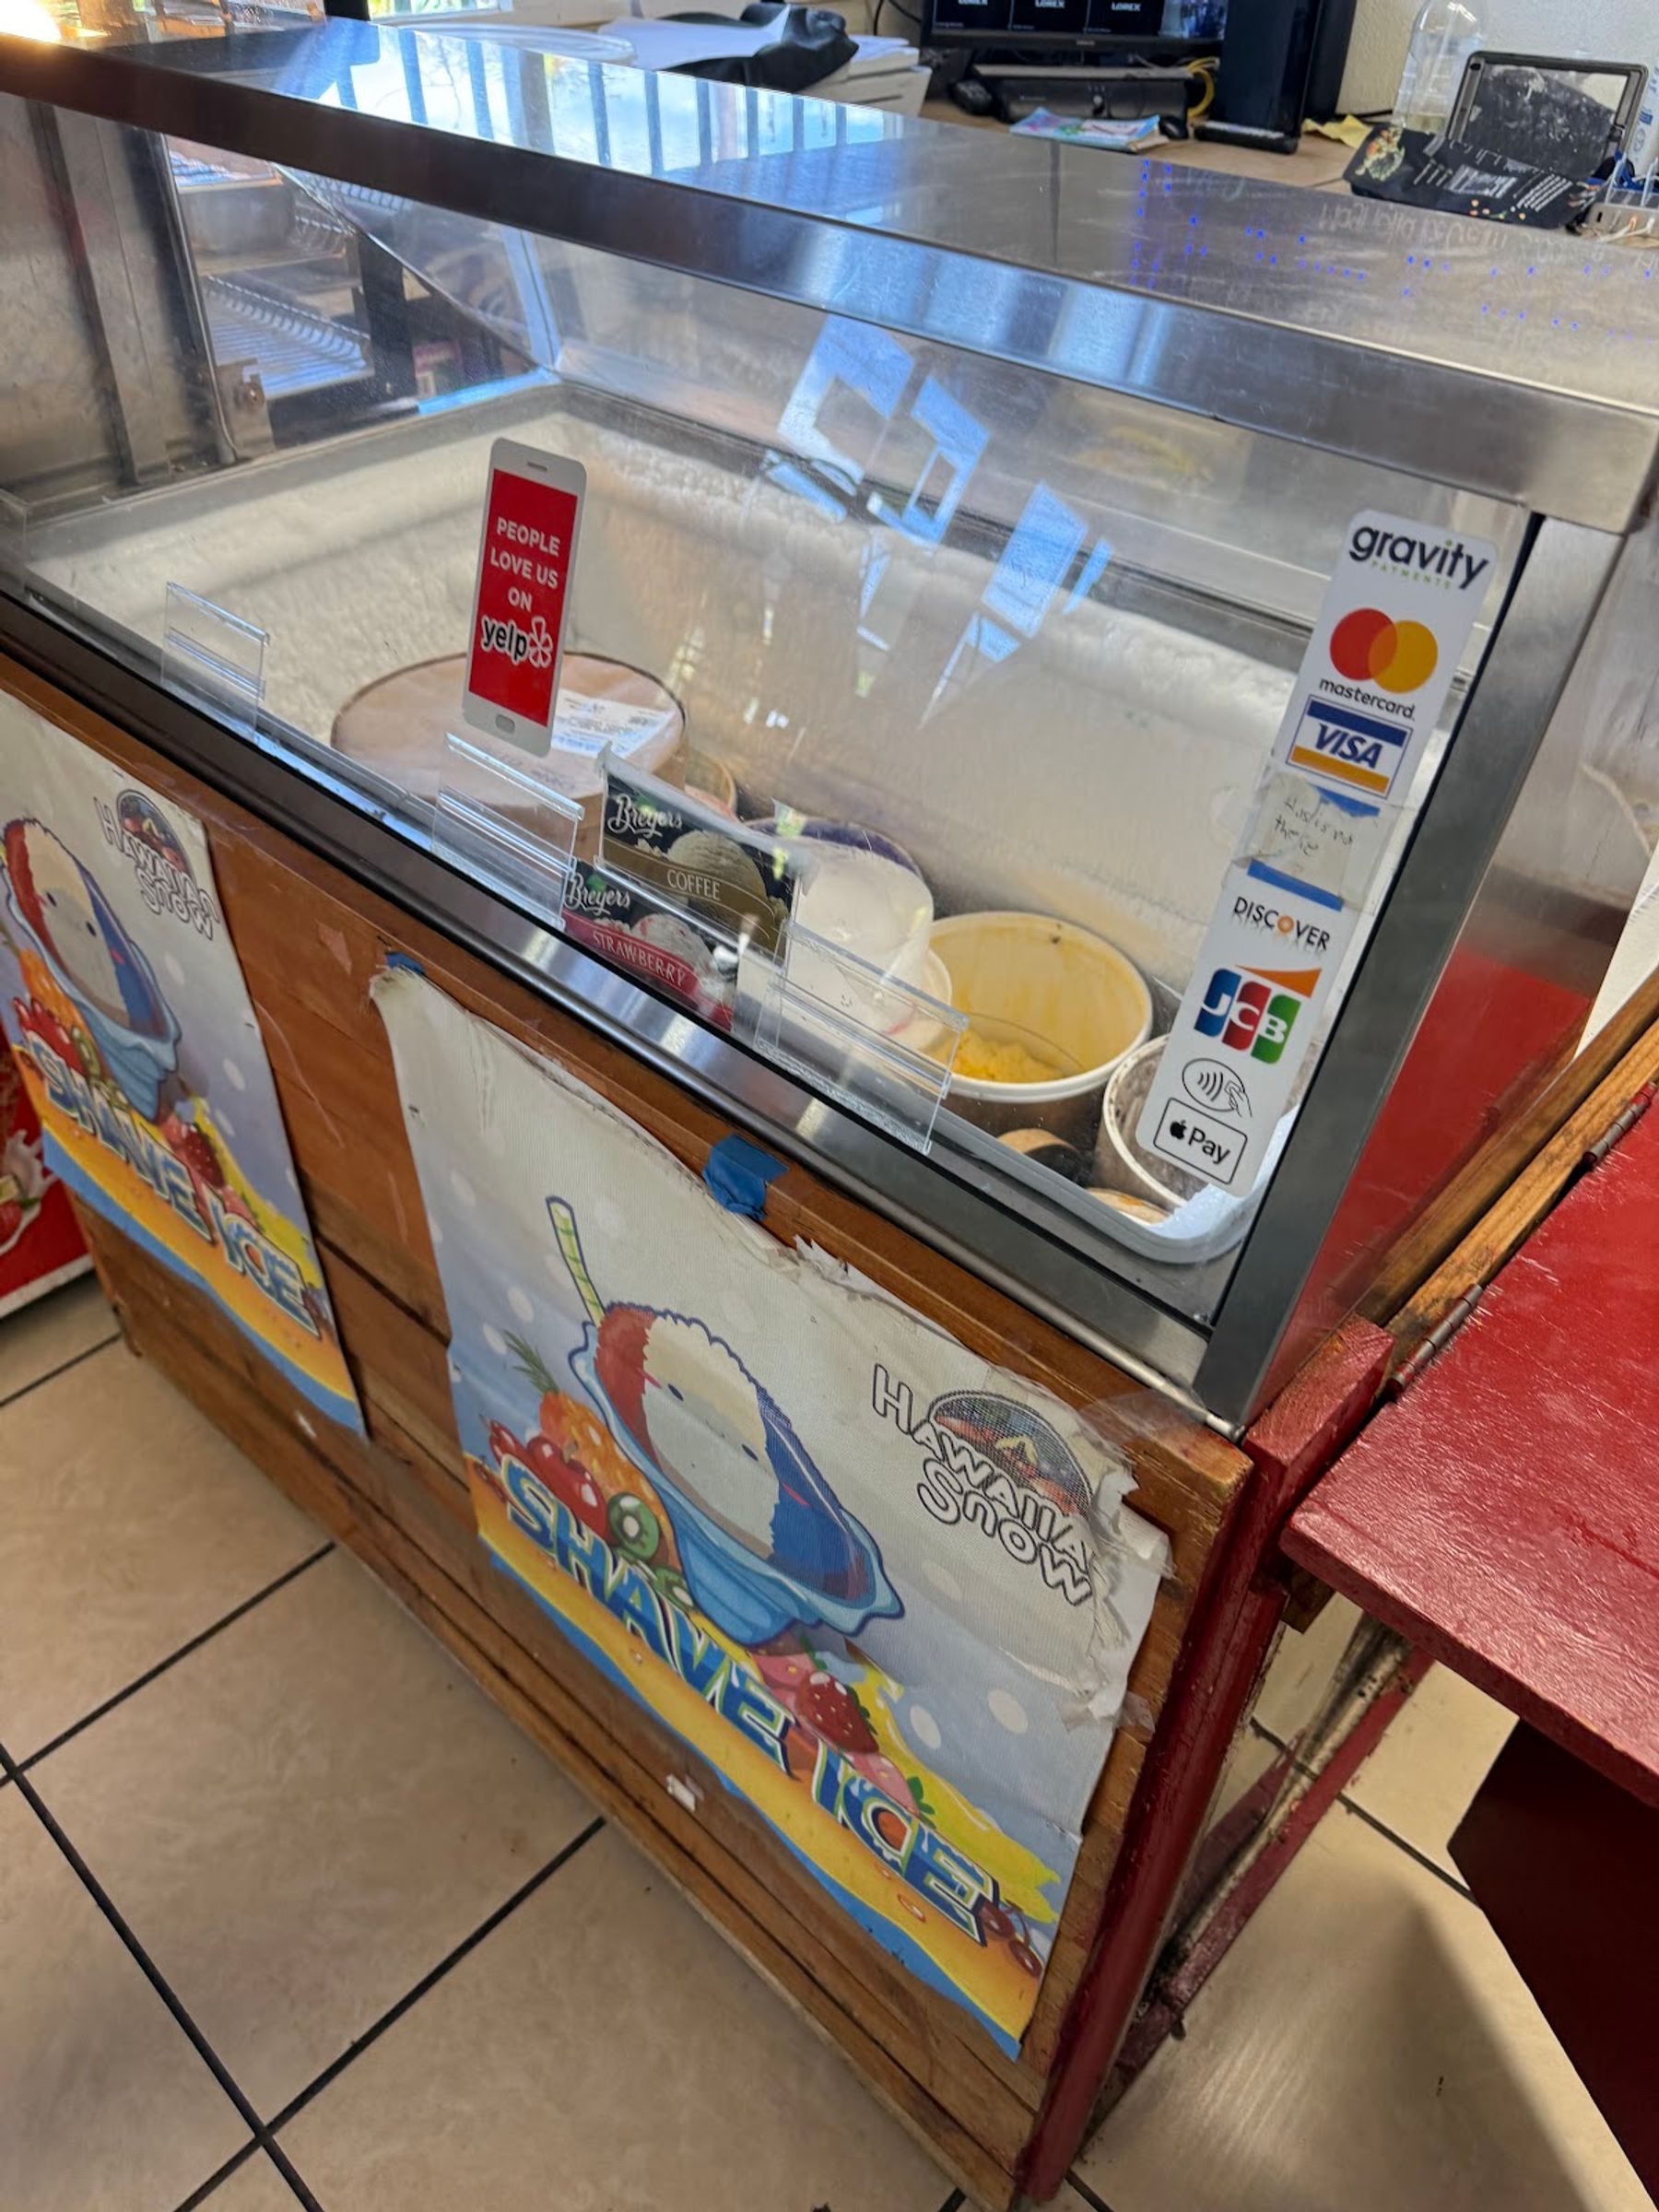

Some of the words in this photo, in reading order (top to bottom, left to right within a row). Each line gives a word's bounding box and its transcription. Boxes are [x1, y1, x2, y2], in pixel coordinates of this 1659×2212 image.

[1111, 2, 1142, 12] LOREX
[497, 517, 560, 557] PEOPLE
[1348, 524, 1488, 590] gravity
[490, 547, 532, 580] LOVE
[536, 568, 559, 590] US
[1371, 560, 1453, 590] PAYMENTS
[508, 587, 533, 613] ON
[482, 617, 528, 664] yelp
[1315, 724, 1383, 769] VISA
[607, 793, 683, 839] Breyers
[563, 872, 630, 915] Breyers
[666, 869, 721, 901] COFFEE
[1232, 896, 1330, 951] DISCOVER
[593, 930, 686, 987] STRAWBERRY
[1188, 1126, 1231, 1166] Pay
[26, 1030, 217, 1247] SHAVE
[200, 1182, 322, 1340] ICE
[873, 1363, 1090, 1578] HAWAIIA
[499, 1453, 798, 1781] SHAVE
[811, 1738, 1001, 1948] ICE
